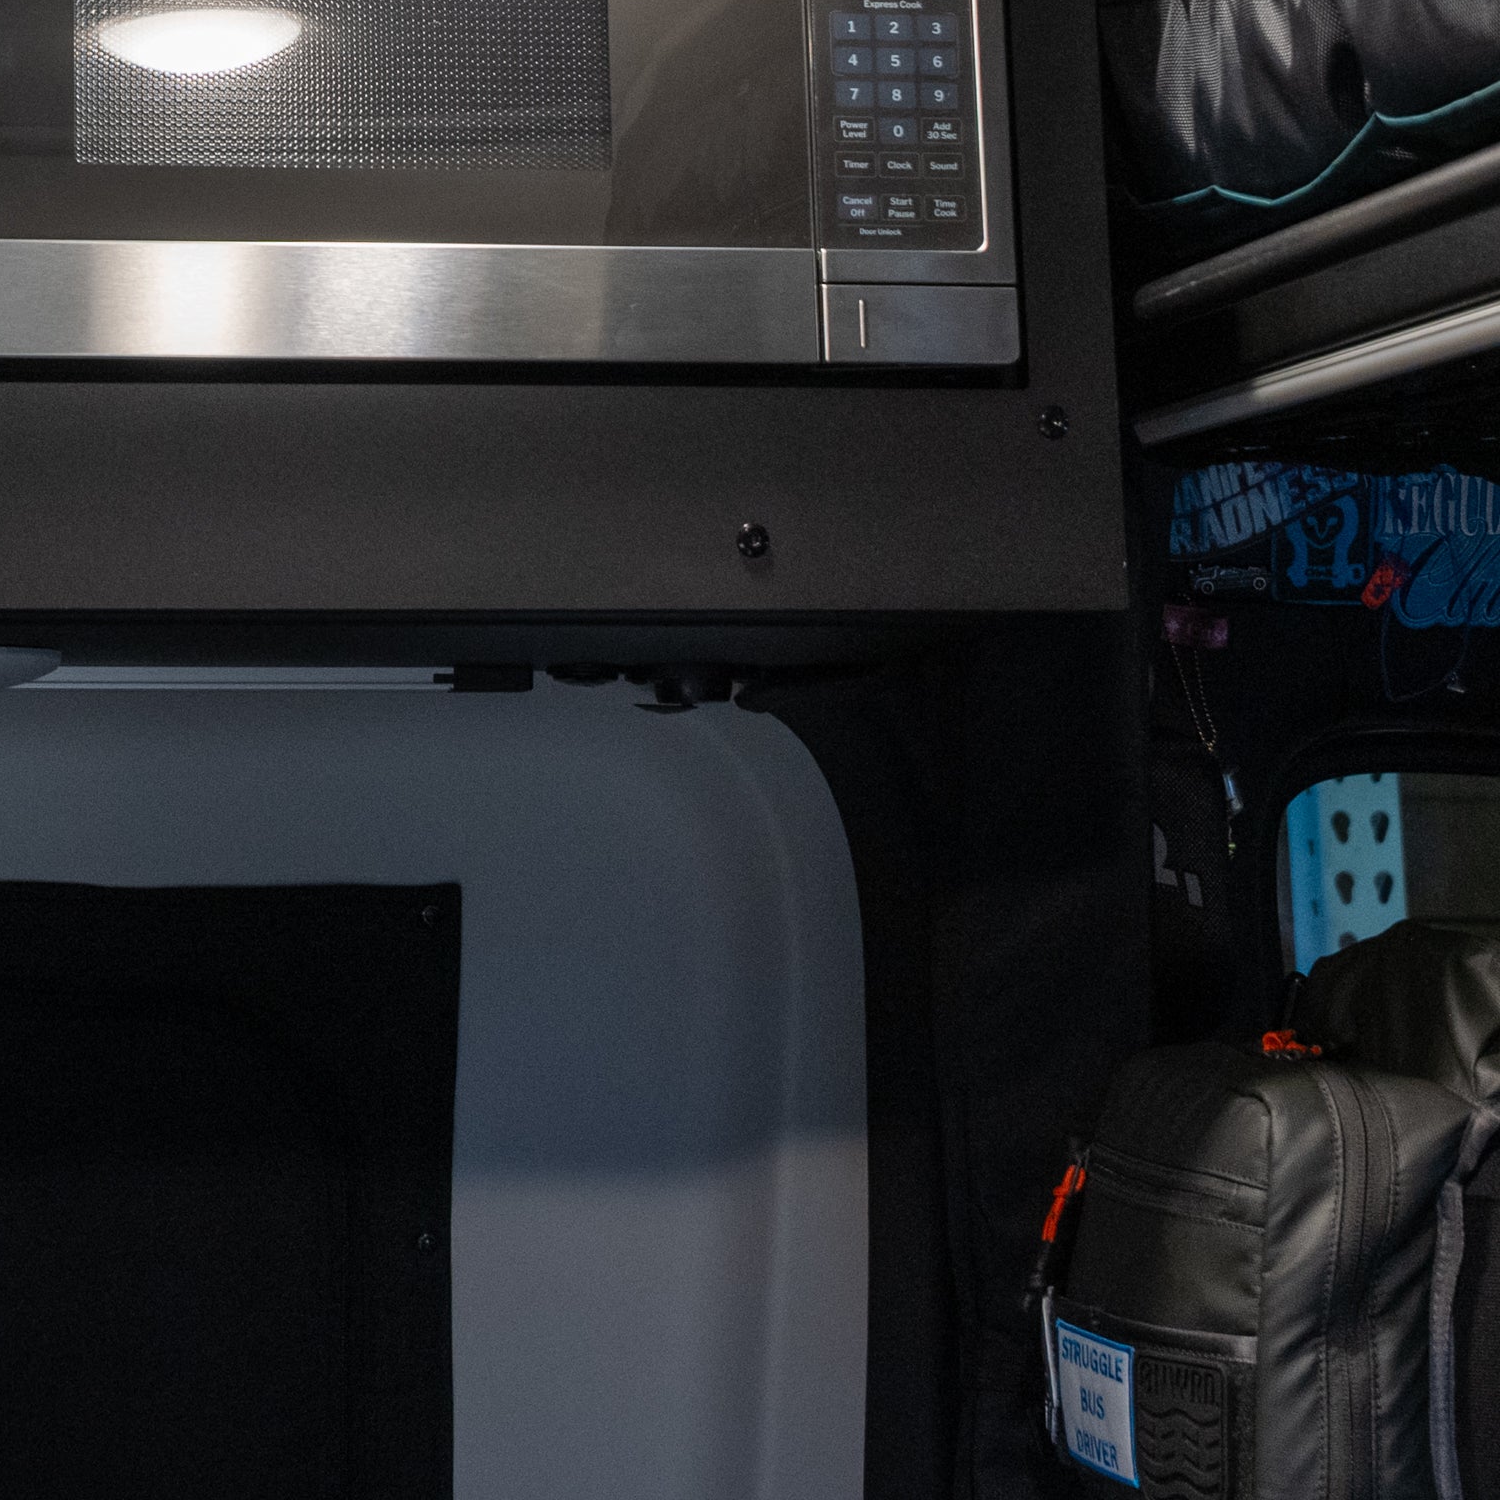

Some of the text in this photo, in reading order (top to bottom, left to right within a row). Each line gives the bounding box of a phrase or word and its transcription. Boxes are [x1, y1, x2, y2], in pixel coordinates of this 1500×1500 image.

[863, 0, 923, 10] Express Cook
[847, 20, 857, 33] 1
[889, 21, 900, 34] 2
[931, 22, 942, 35] 3
[847, 53, 858, 67] 4
[890, 54, 901, 68] 5
[932, 55, 943, 68] 6
[849, 87, 860, 101] 7
[891, 88, 903, 102] 8
[933, 89, 945, 102] 9
[840, 120, 868, 129] Power
[933, 122, 951, 131] Add
[842, 130, 867, 139] Level
[892, 124, 904, 138] 0
[927, 131, 957, 140] 30 Sec
[843, 159, 869, 169] Timer
[887, 160, 913, 170] Clock
[929, 161, 958, 170] Sound
[842, 196, 873, 205] Cancel
[890, 197, 913, 206] Start
[933, 199, 957, 208] Time
[850, 208, 866, 217] Off
[888, 209, 916, 218] Pause
[933, 208, 957, 218] Cook
[859, 227, 902, 236] Door Unlock
[1060, 1336, 1124, 1384] STRUGGLE
[1079, 1386, 1106, 1421] BUS
[1075, 1429, 1120, 1471] DRIVER
